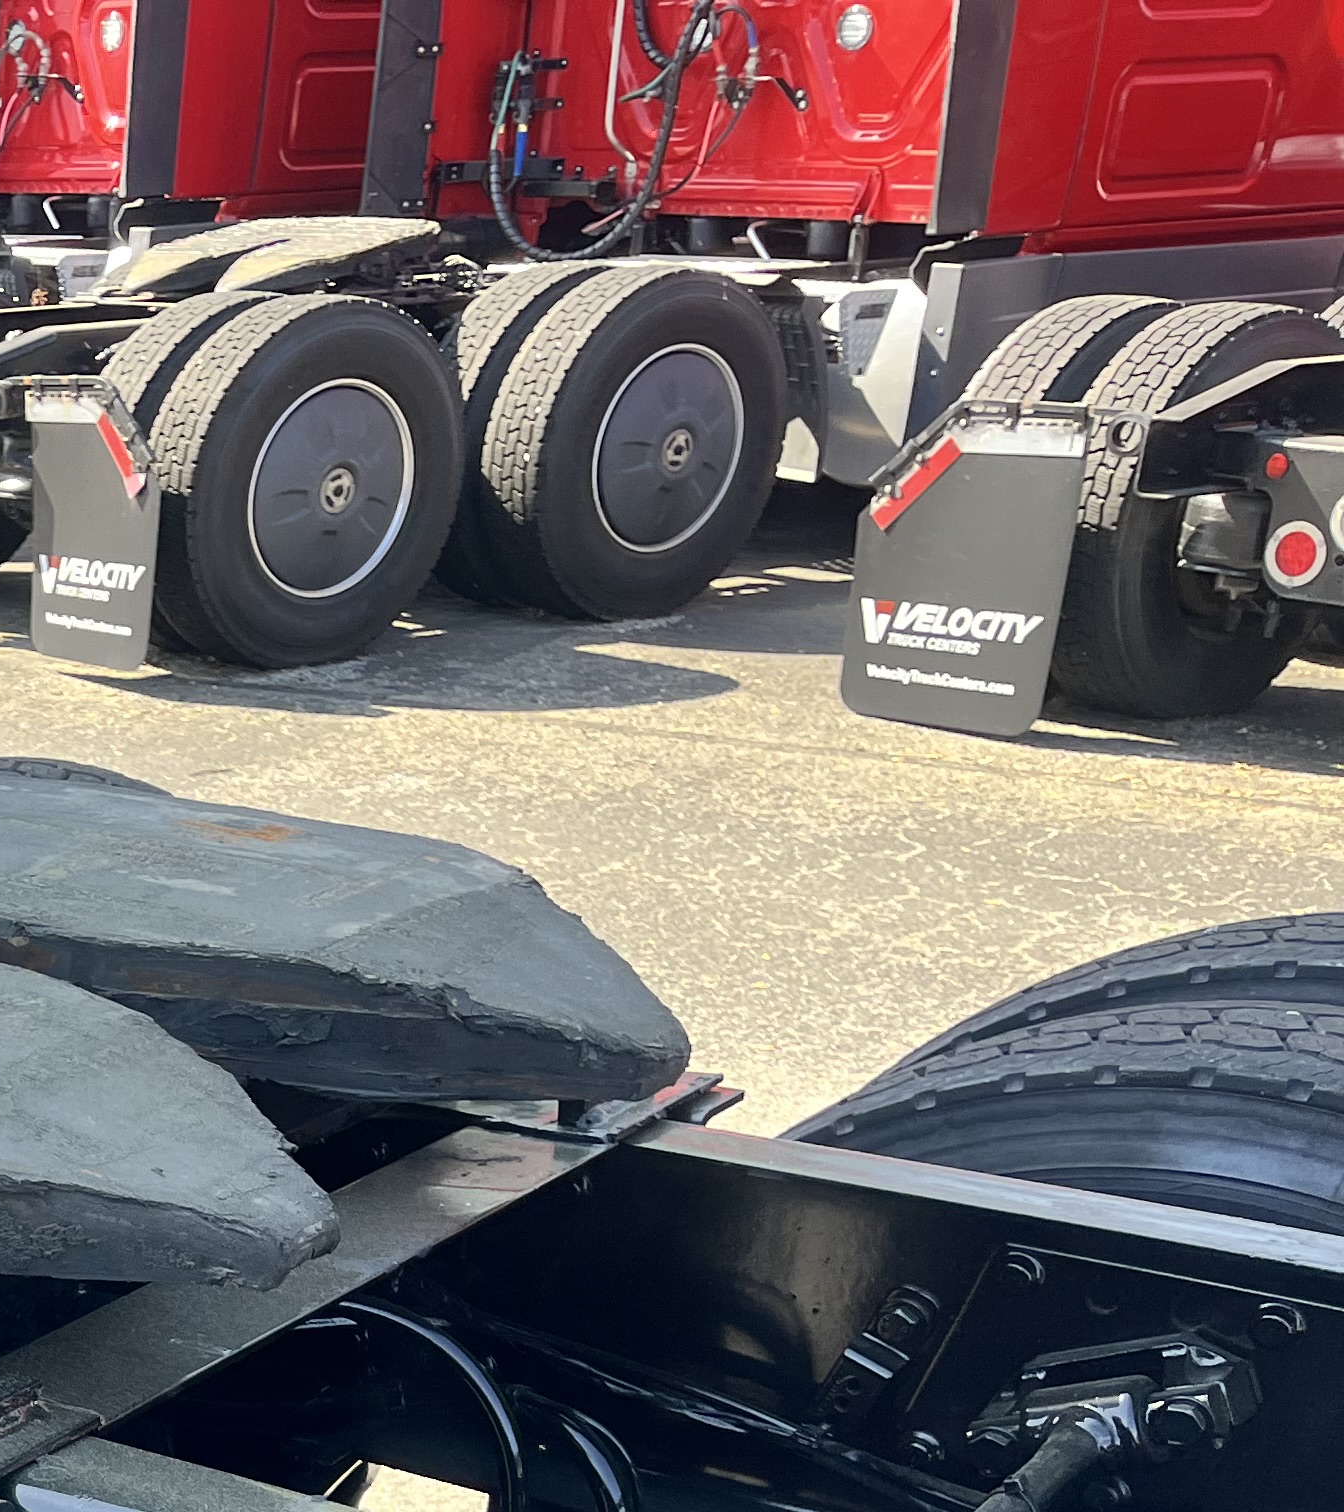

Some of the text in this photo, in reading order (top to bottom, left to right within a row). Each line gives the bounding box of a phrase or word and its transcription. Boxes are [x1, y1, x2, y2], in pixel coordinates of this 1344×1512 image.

[58, 556, 146, 591] VELOCITY
[892, 601, 1044, 644] VELOCITY
[887, 632, 982, 656] TRUCK CENTERS
